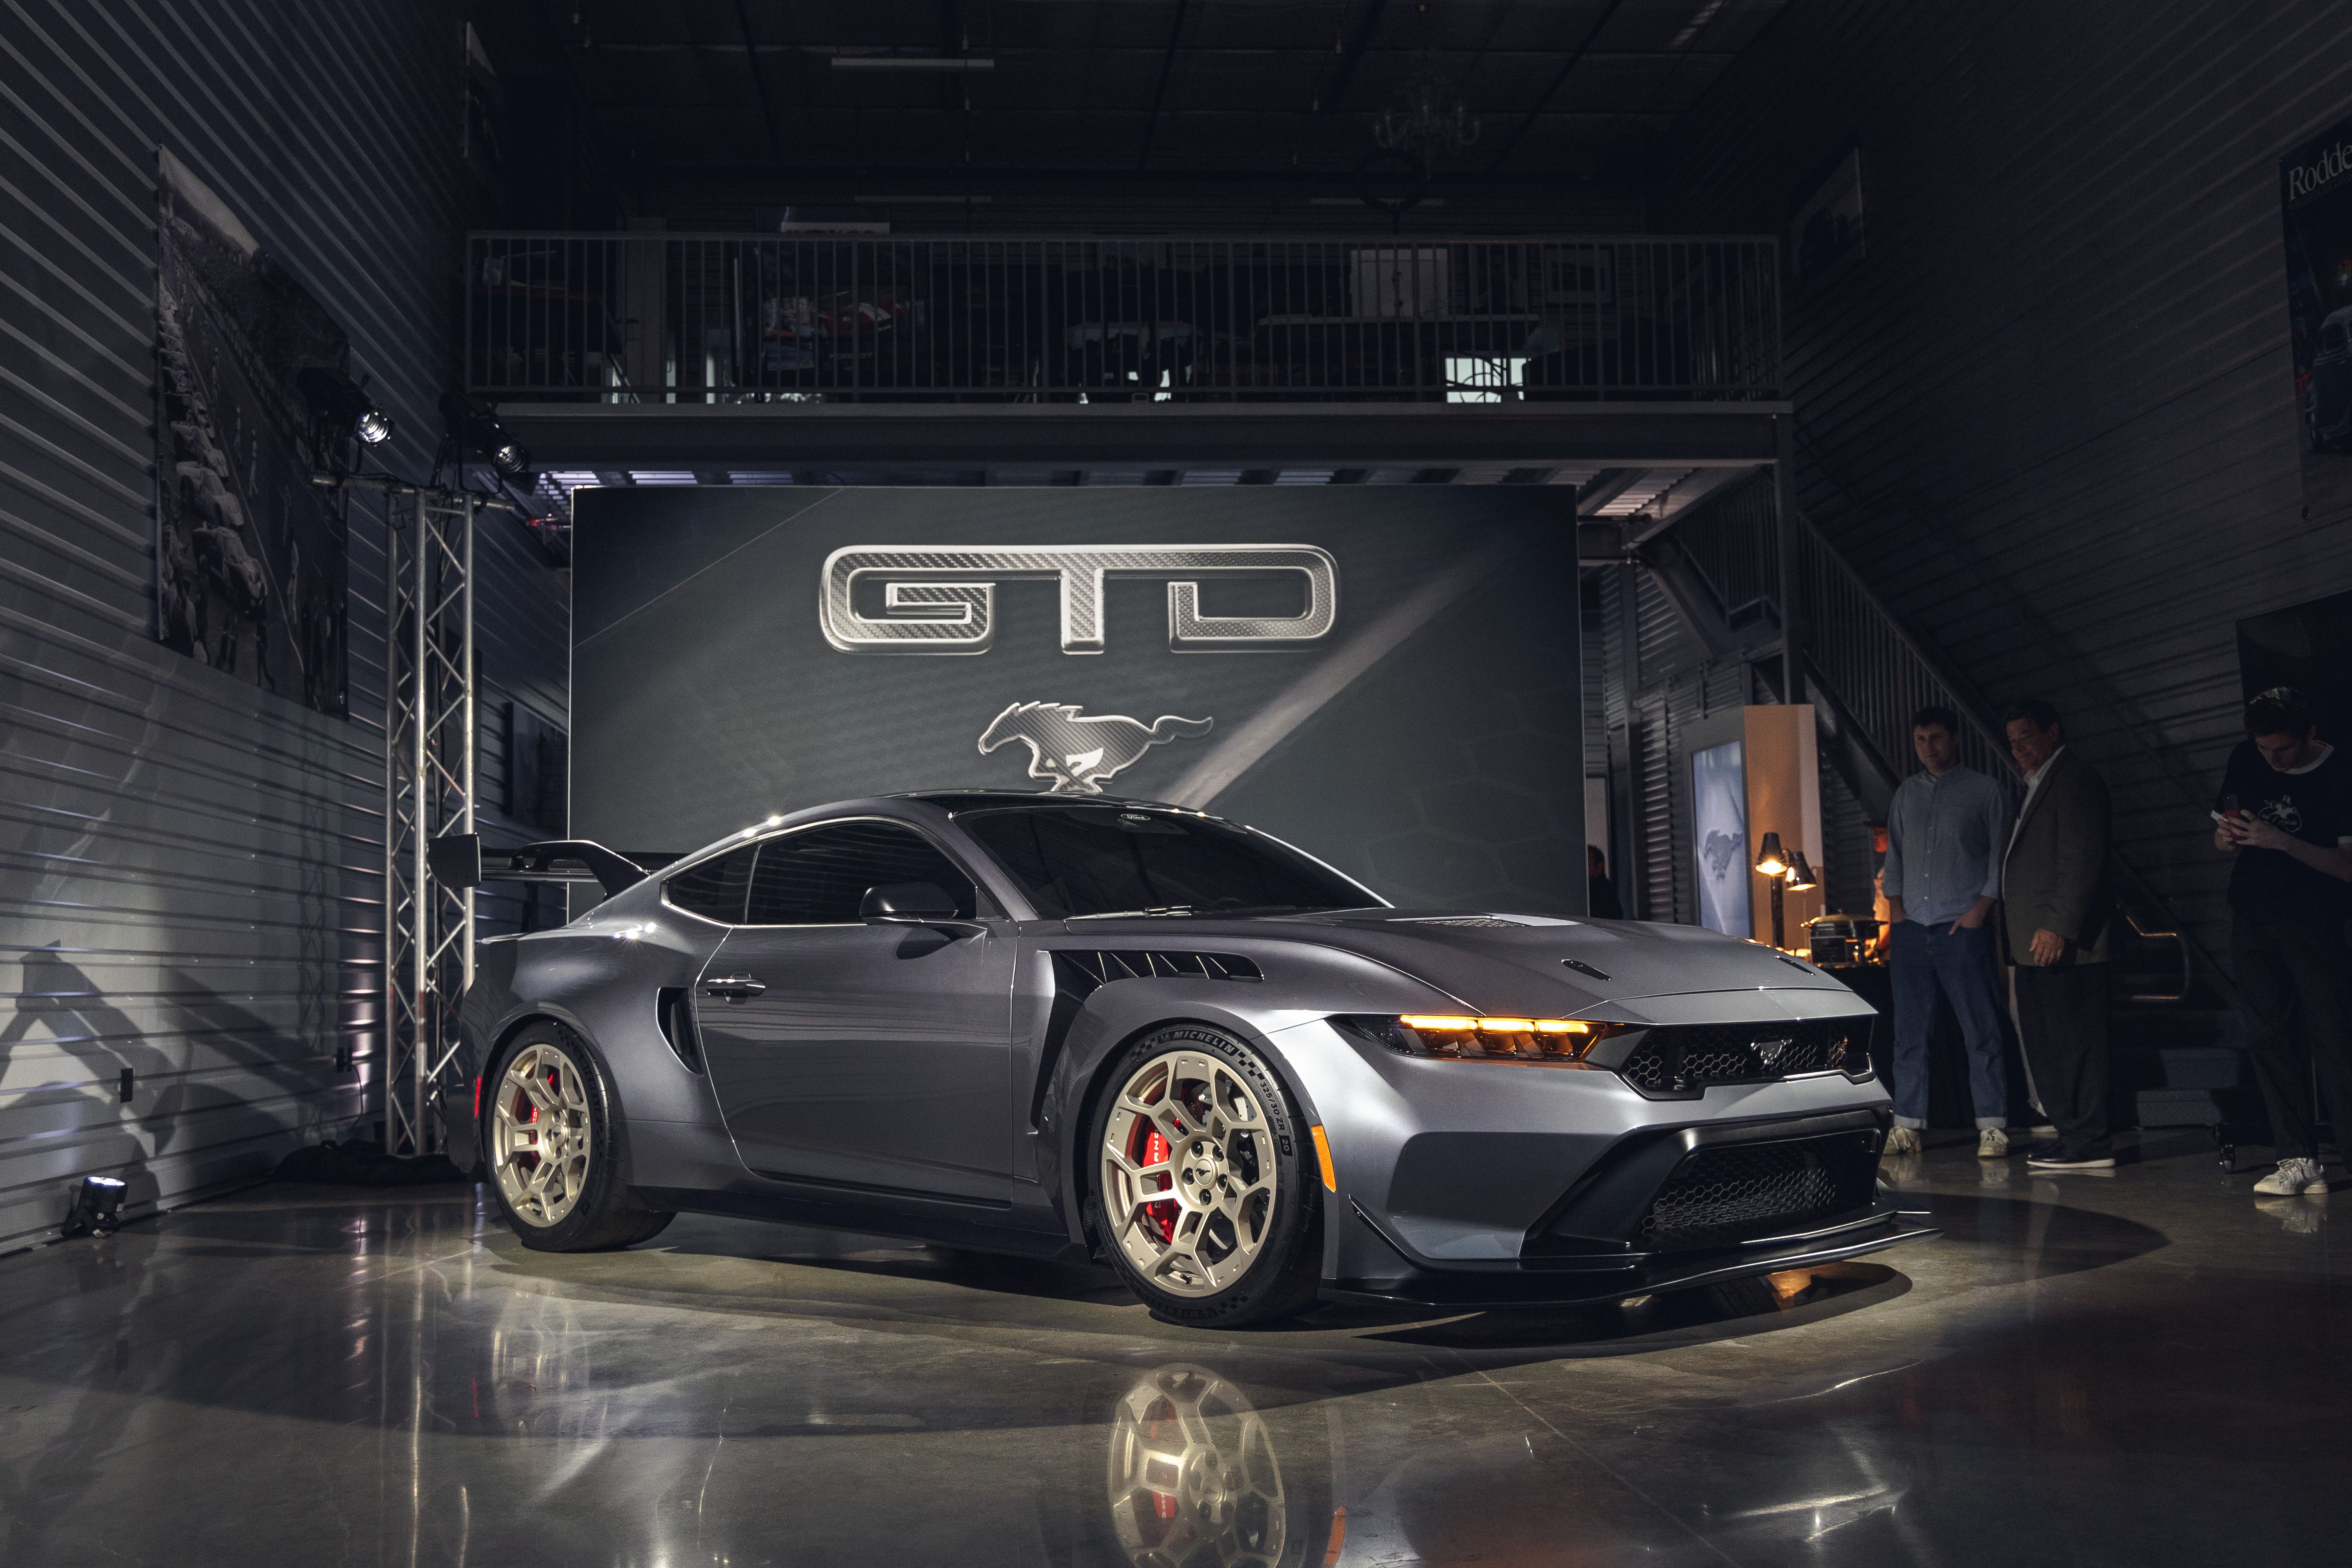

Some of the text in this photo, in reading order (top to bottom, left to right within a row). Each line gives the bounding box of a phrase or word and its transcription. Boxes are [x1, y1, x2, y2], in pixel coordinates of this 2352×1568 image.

[820, 544, 1339, 654] GTD
[1173, 1031, 1235, 1053] MICHELIN
[1260, 1082, 1289, 1151] 325/30 ZR 20
